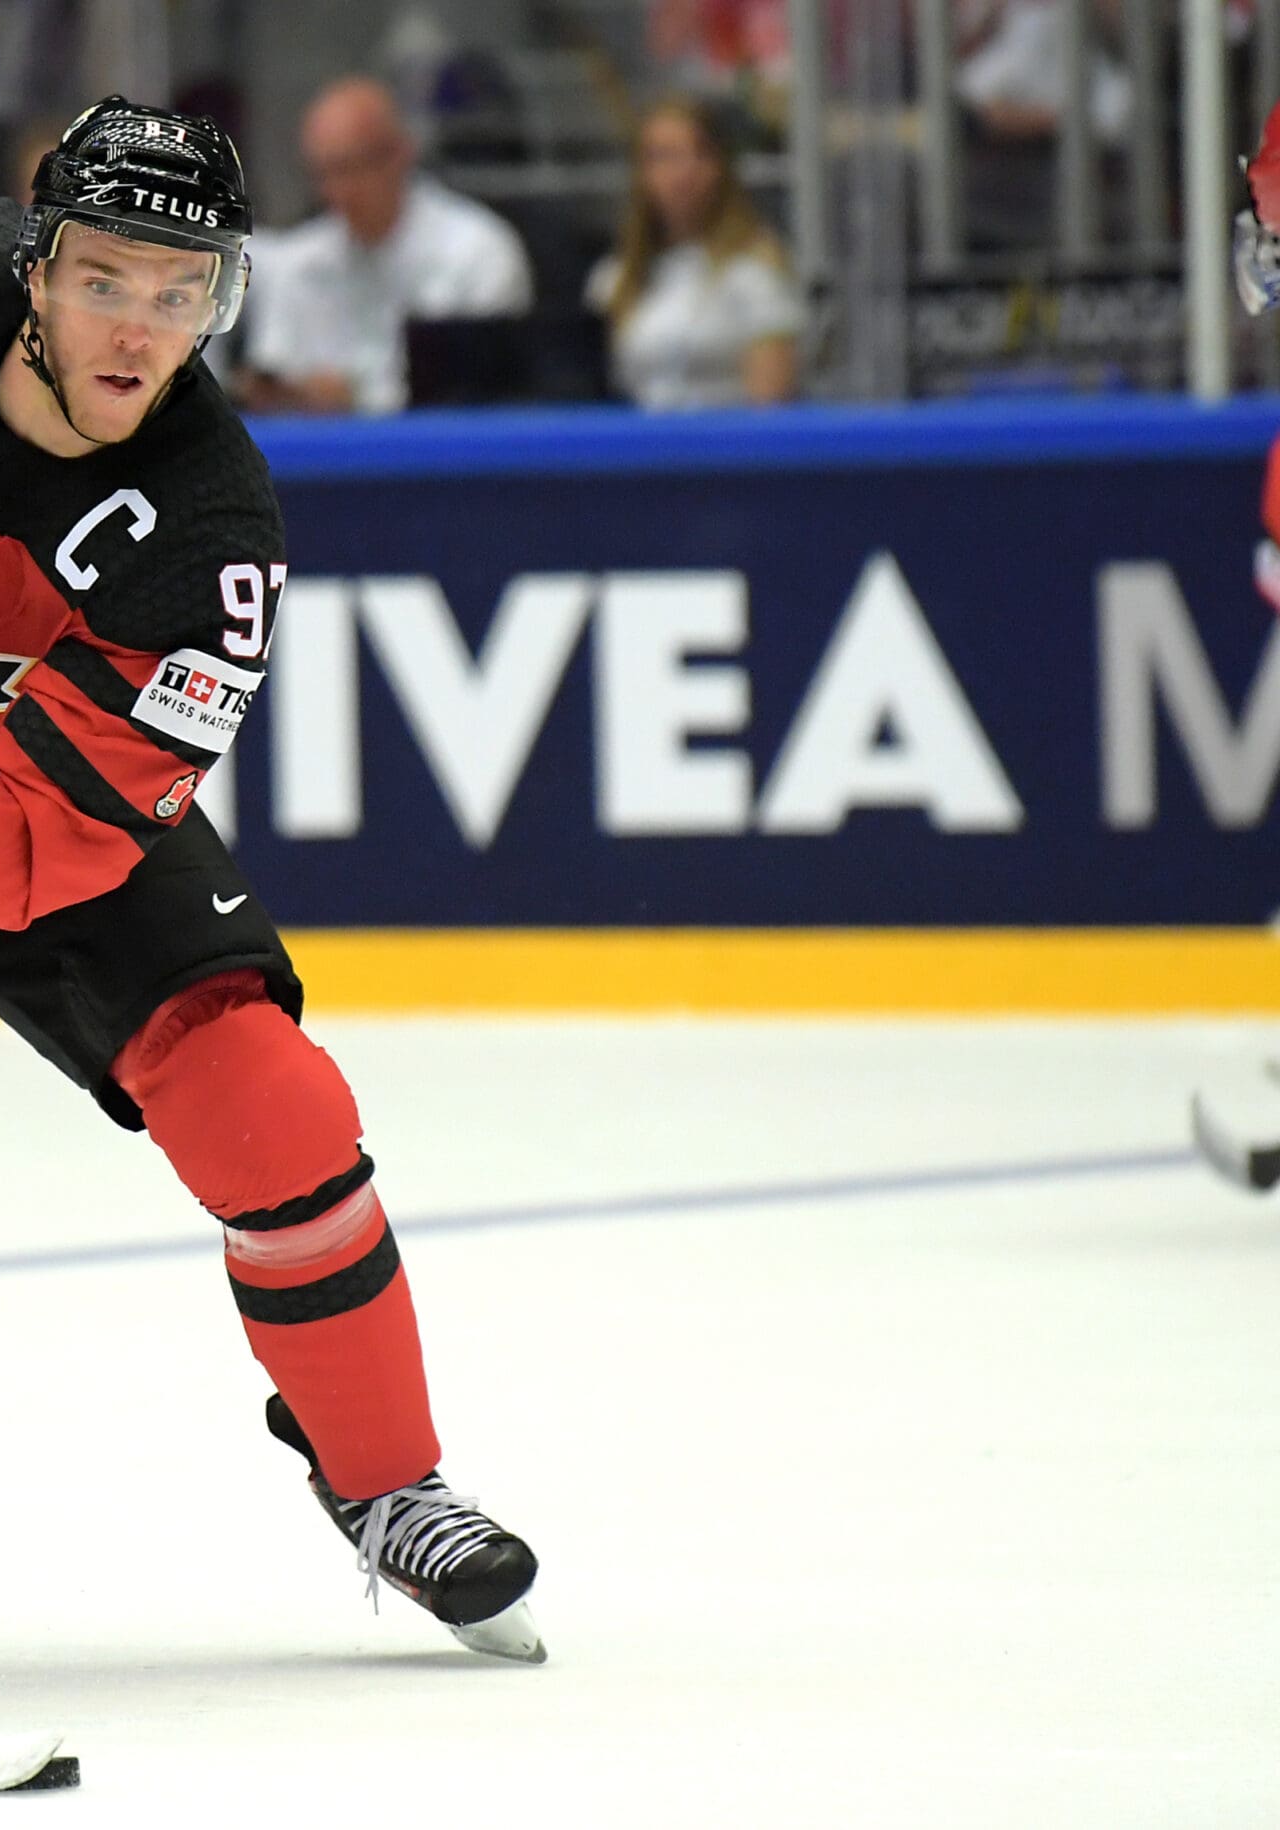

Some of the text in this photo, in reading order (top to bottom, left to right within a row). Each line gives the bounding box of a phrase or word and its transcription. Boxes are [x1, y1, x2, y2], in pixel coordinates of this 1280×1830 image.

[132, 188, 219, 228] TELUS
[55, 489, 157, 590] C
[148, 688, 196, 719] SWISS
[196, 552, 1024, 850] IVEA
